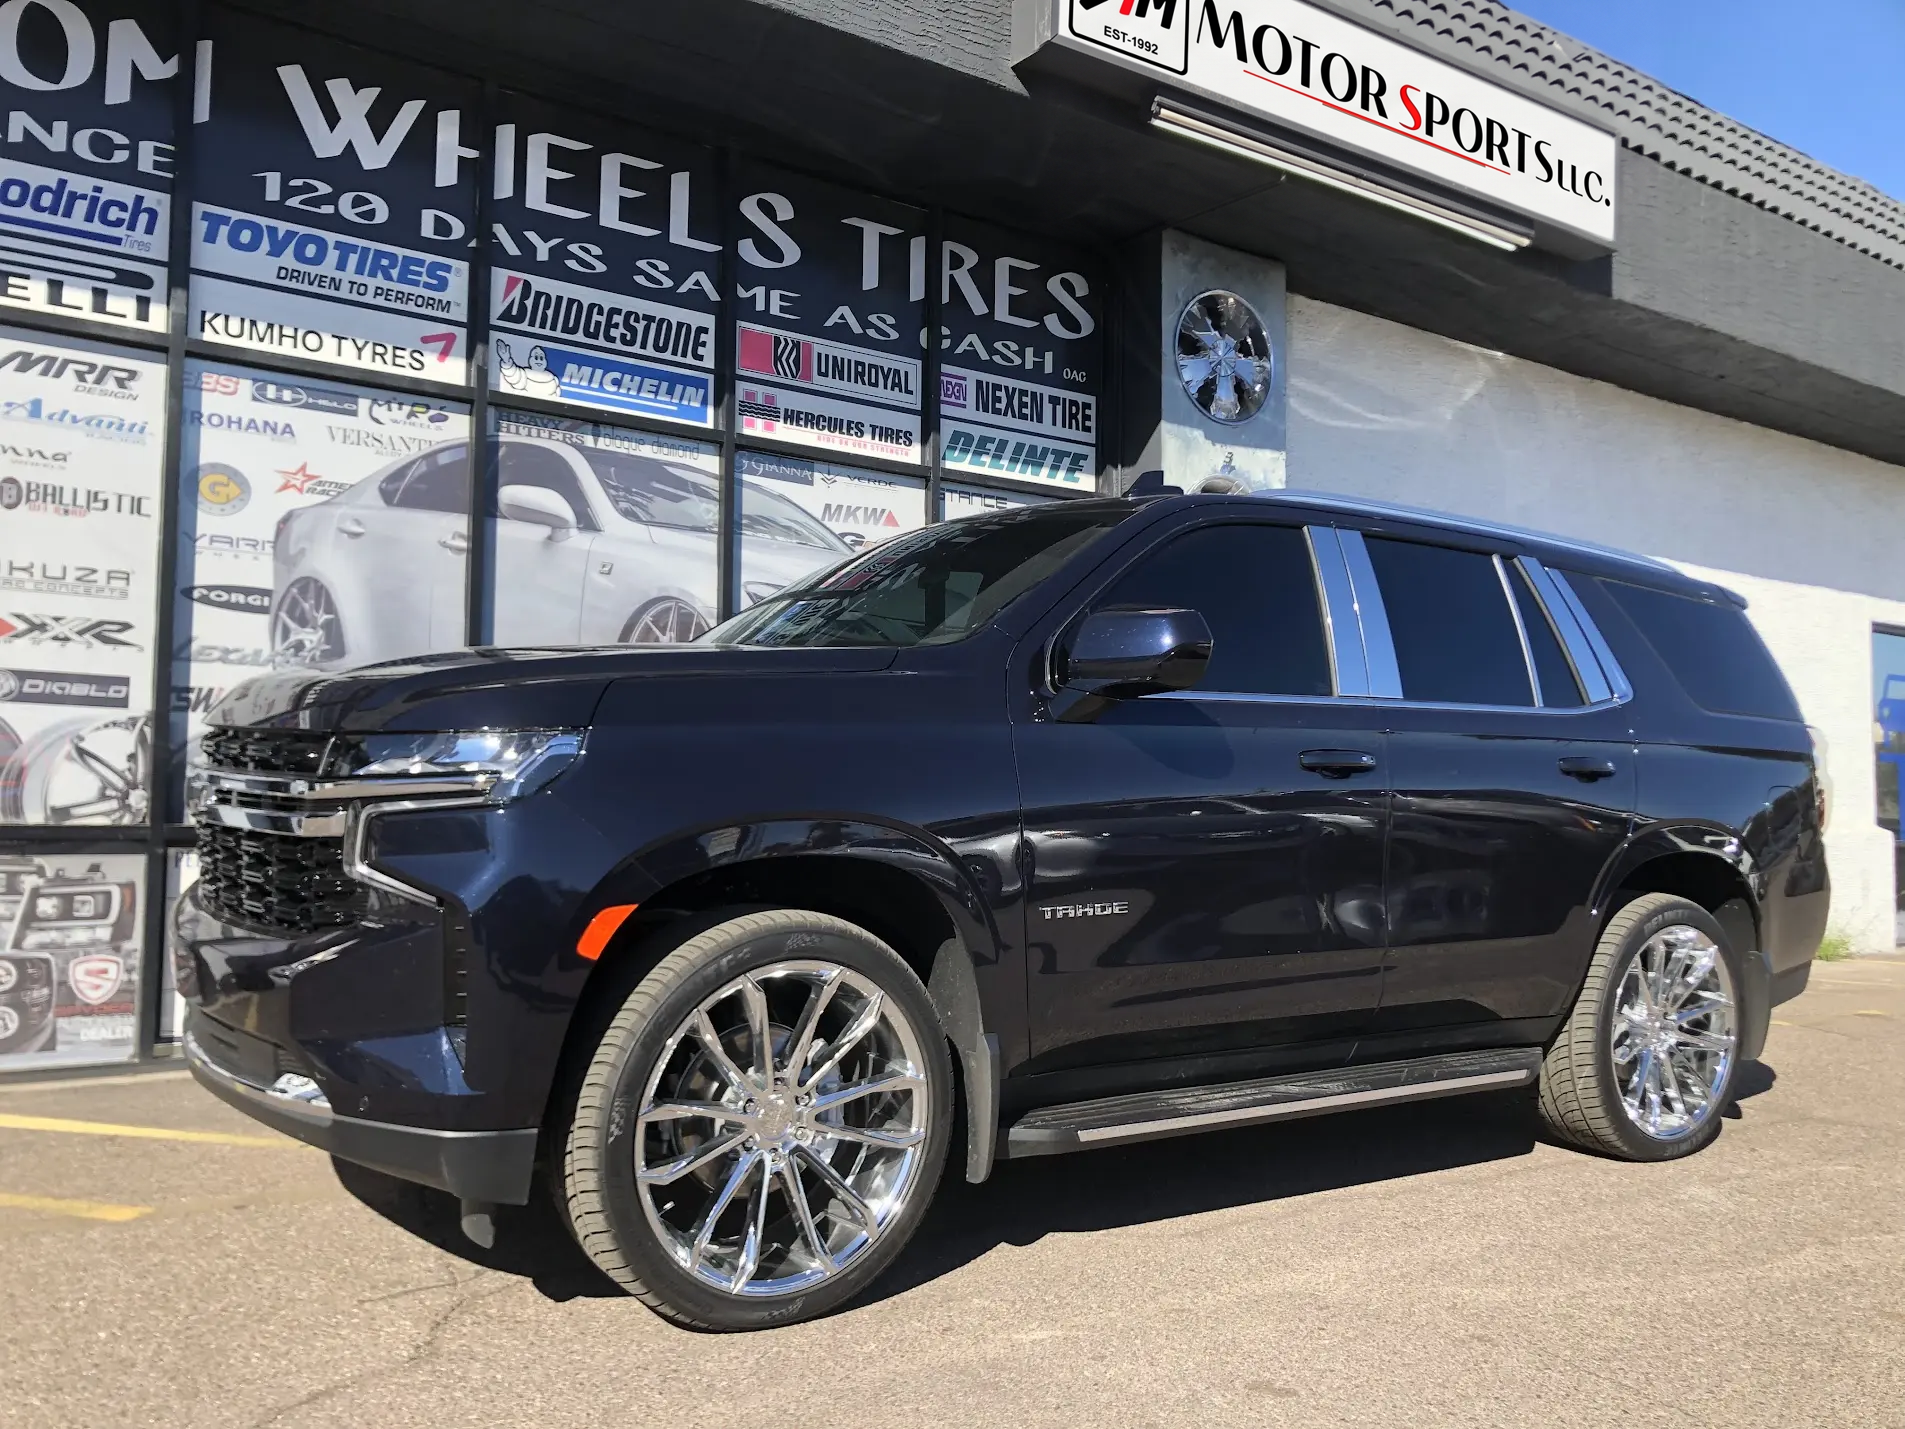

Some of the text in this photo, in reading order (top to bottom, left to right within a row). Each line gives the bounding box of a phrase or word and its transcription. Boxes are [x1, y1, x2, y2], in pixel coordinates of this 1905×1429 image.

[1103, 25, 1159, 56] EST-1992
[1197, 0, 1389, 120] MOTOR
[275, 64, 803, 269] WHEELS
[841, 217, 1096, 340] TIRES
[121, 233, 152, 253] Tires
[200, 210, 453, 293] TOYO TIRES
[251, 171, 390, 225] 120
[419, 208, 608, 274] DAYS
[822, 305, 901, 342] AS
[918, 325, 1053, 375] CASH
[1062, 367, 1088, 384] OAC
[275, 265, 452, 315] DRIVEN TO PERFORM
[199, 310, 426, 372] KUMHO TYRES
[496, 274, 711, 363] BRIDGESTONE
[73, 384, 140, 402] DESIGN
[562, 362, 706, 407] MICHELIN
[815, 350, 915, 396] UNIROYAL
[3, 397, 149, 435] Advanti
[189, 409, 296, 438] ROHANA
[782, 406, 914, 448] HERCULES TIRES
[974, 379, 1093, 435] NEXEN TIRE
[941, 429, 1090, 485] DELINTE
[25, 480, 152, 518] BALLISTIC
[1039, 901, 1129, 920] TAHOE
